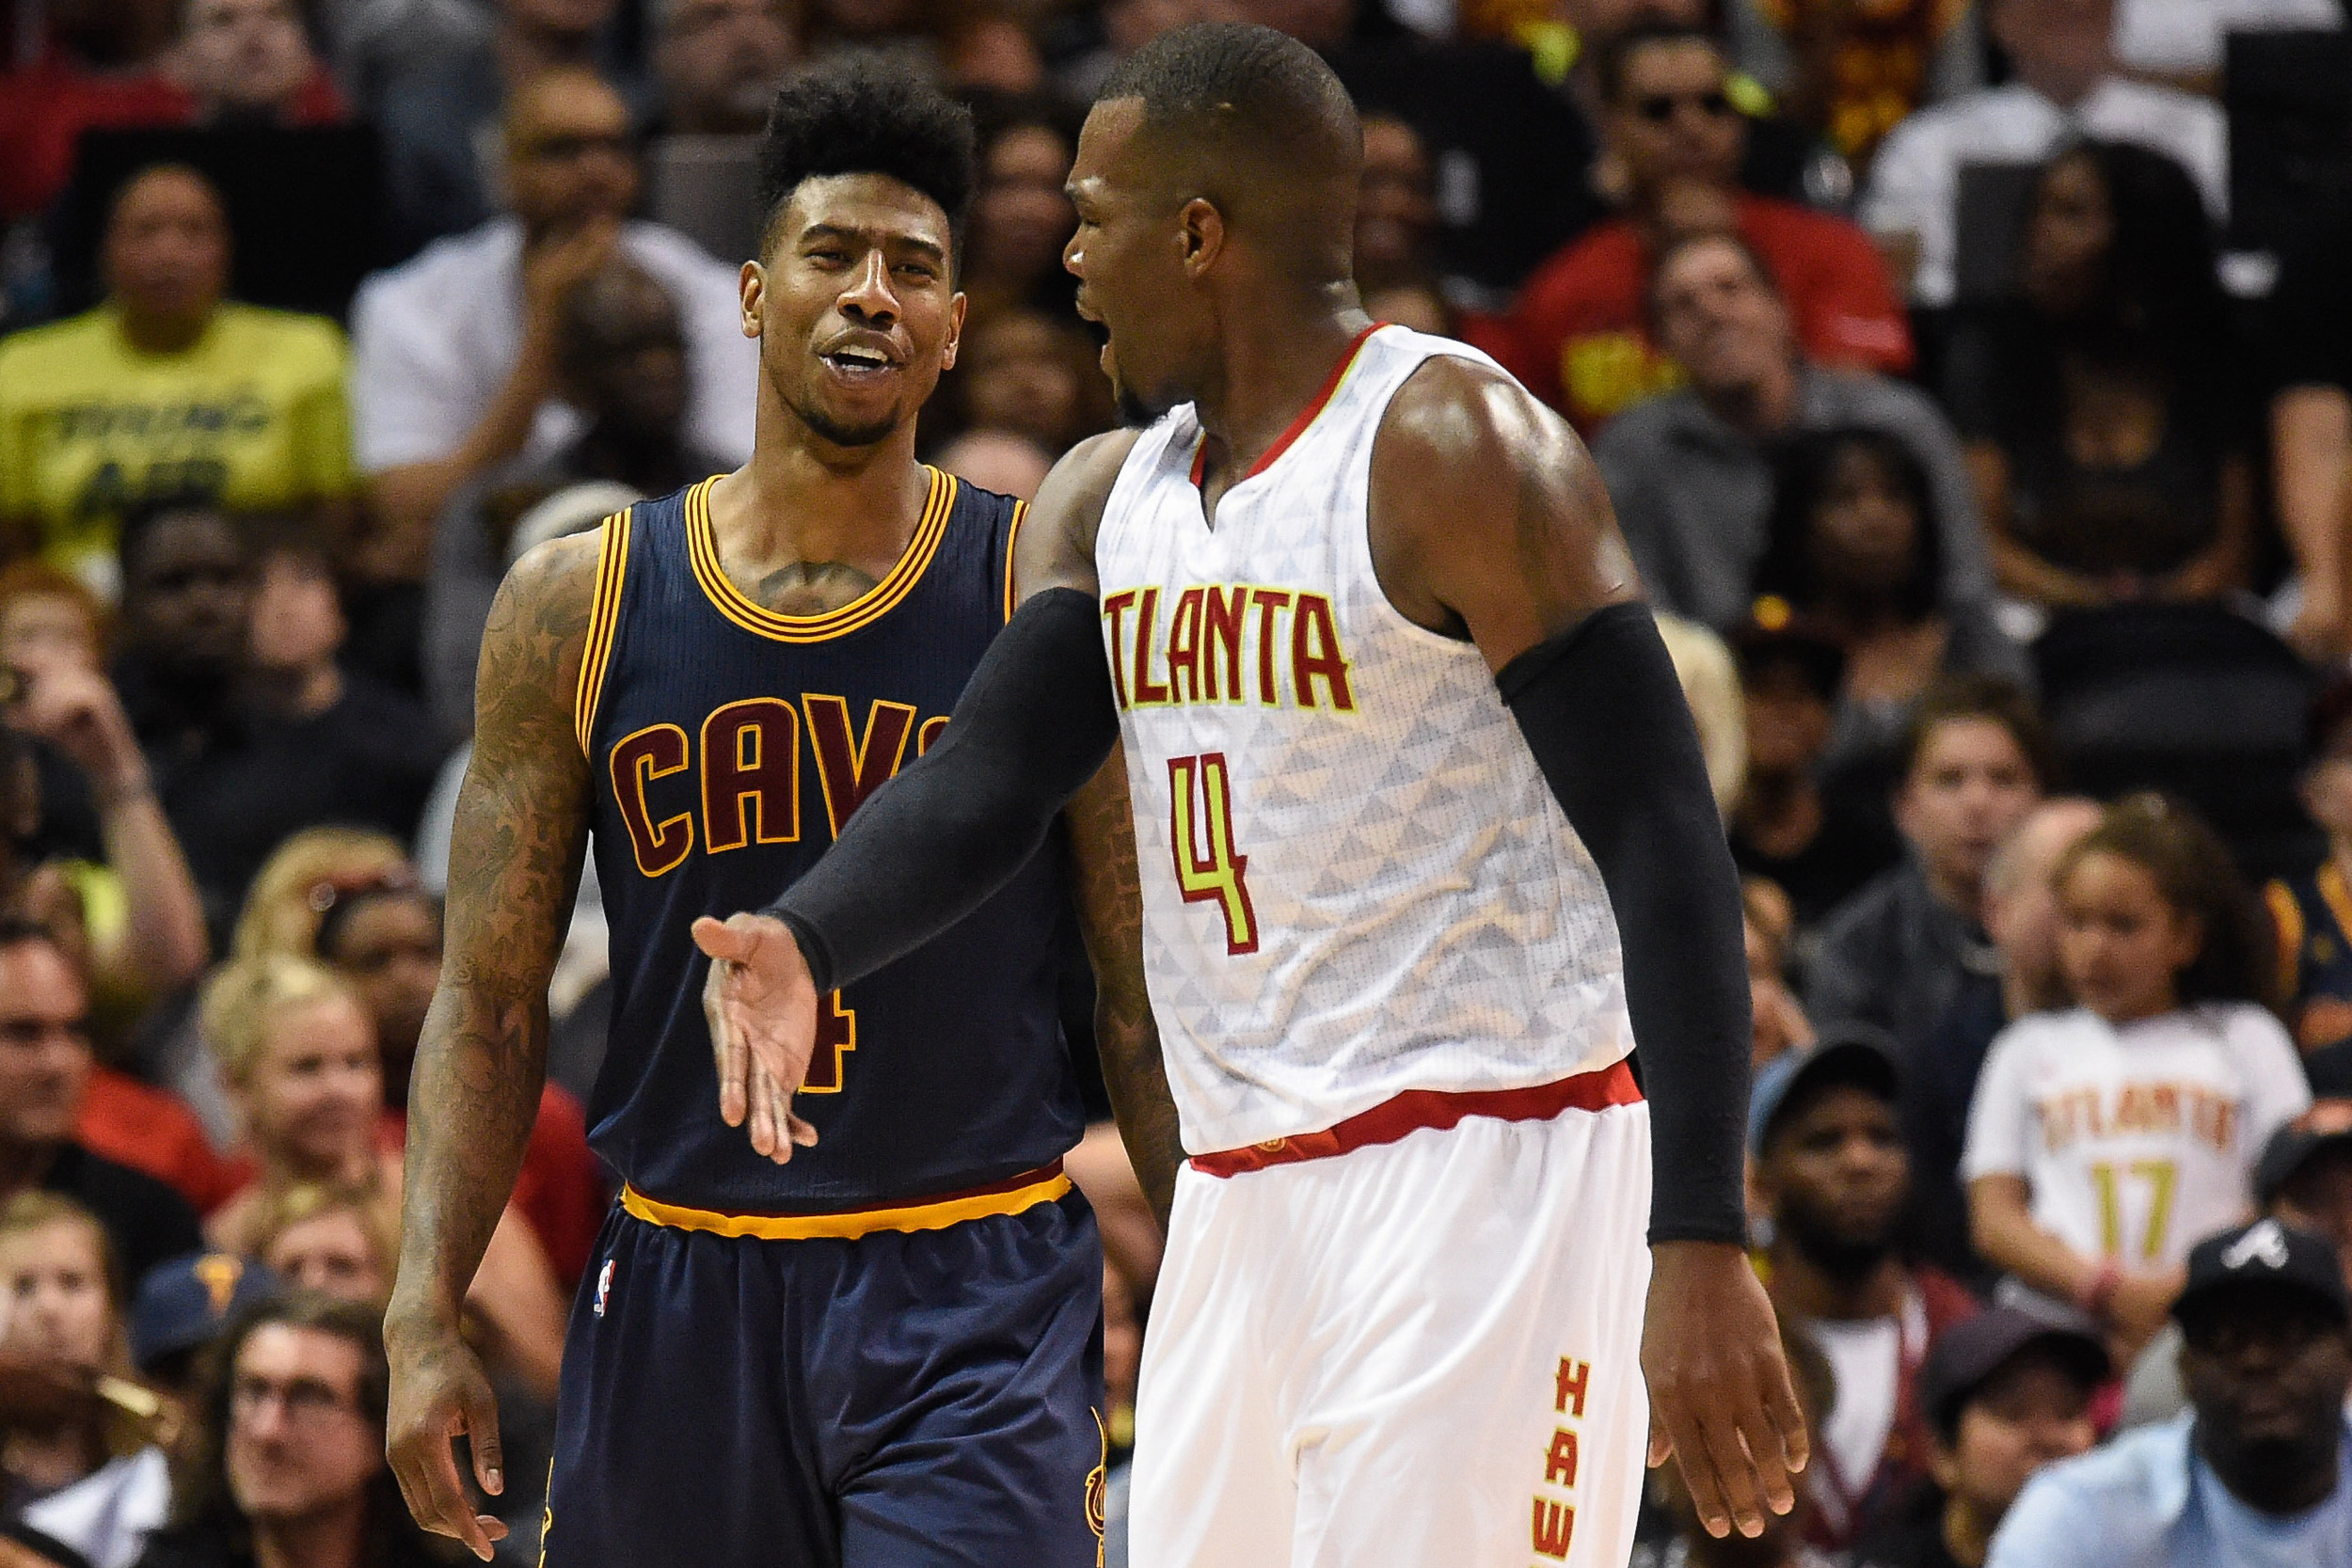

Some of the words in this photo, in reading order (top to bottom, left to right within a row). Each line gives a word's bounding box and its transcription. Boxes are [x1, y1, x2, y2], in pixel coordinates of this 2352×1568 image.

[1103, 582, 1359, 713] TLANTA
[610, 692, 950, 877] CAV
[1168, 752, 1259, 956] 4
[2091, 1160, 2179, 1259] 17
[1530, 1355, 1591, 1566] HAW
